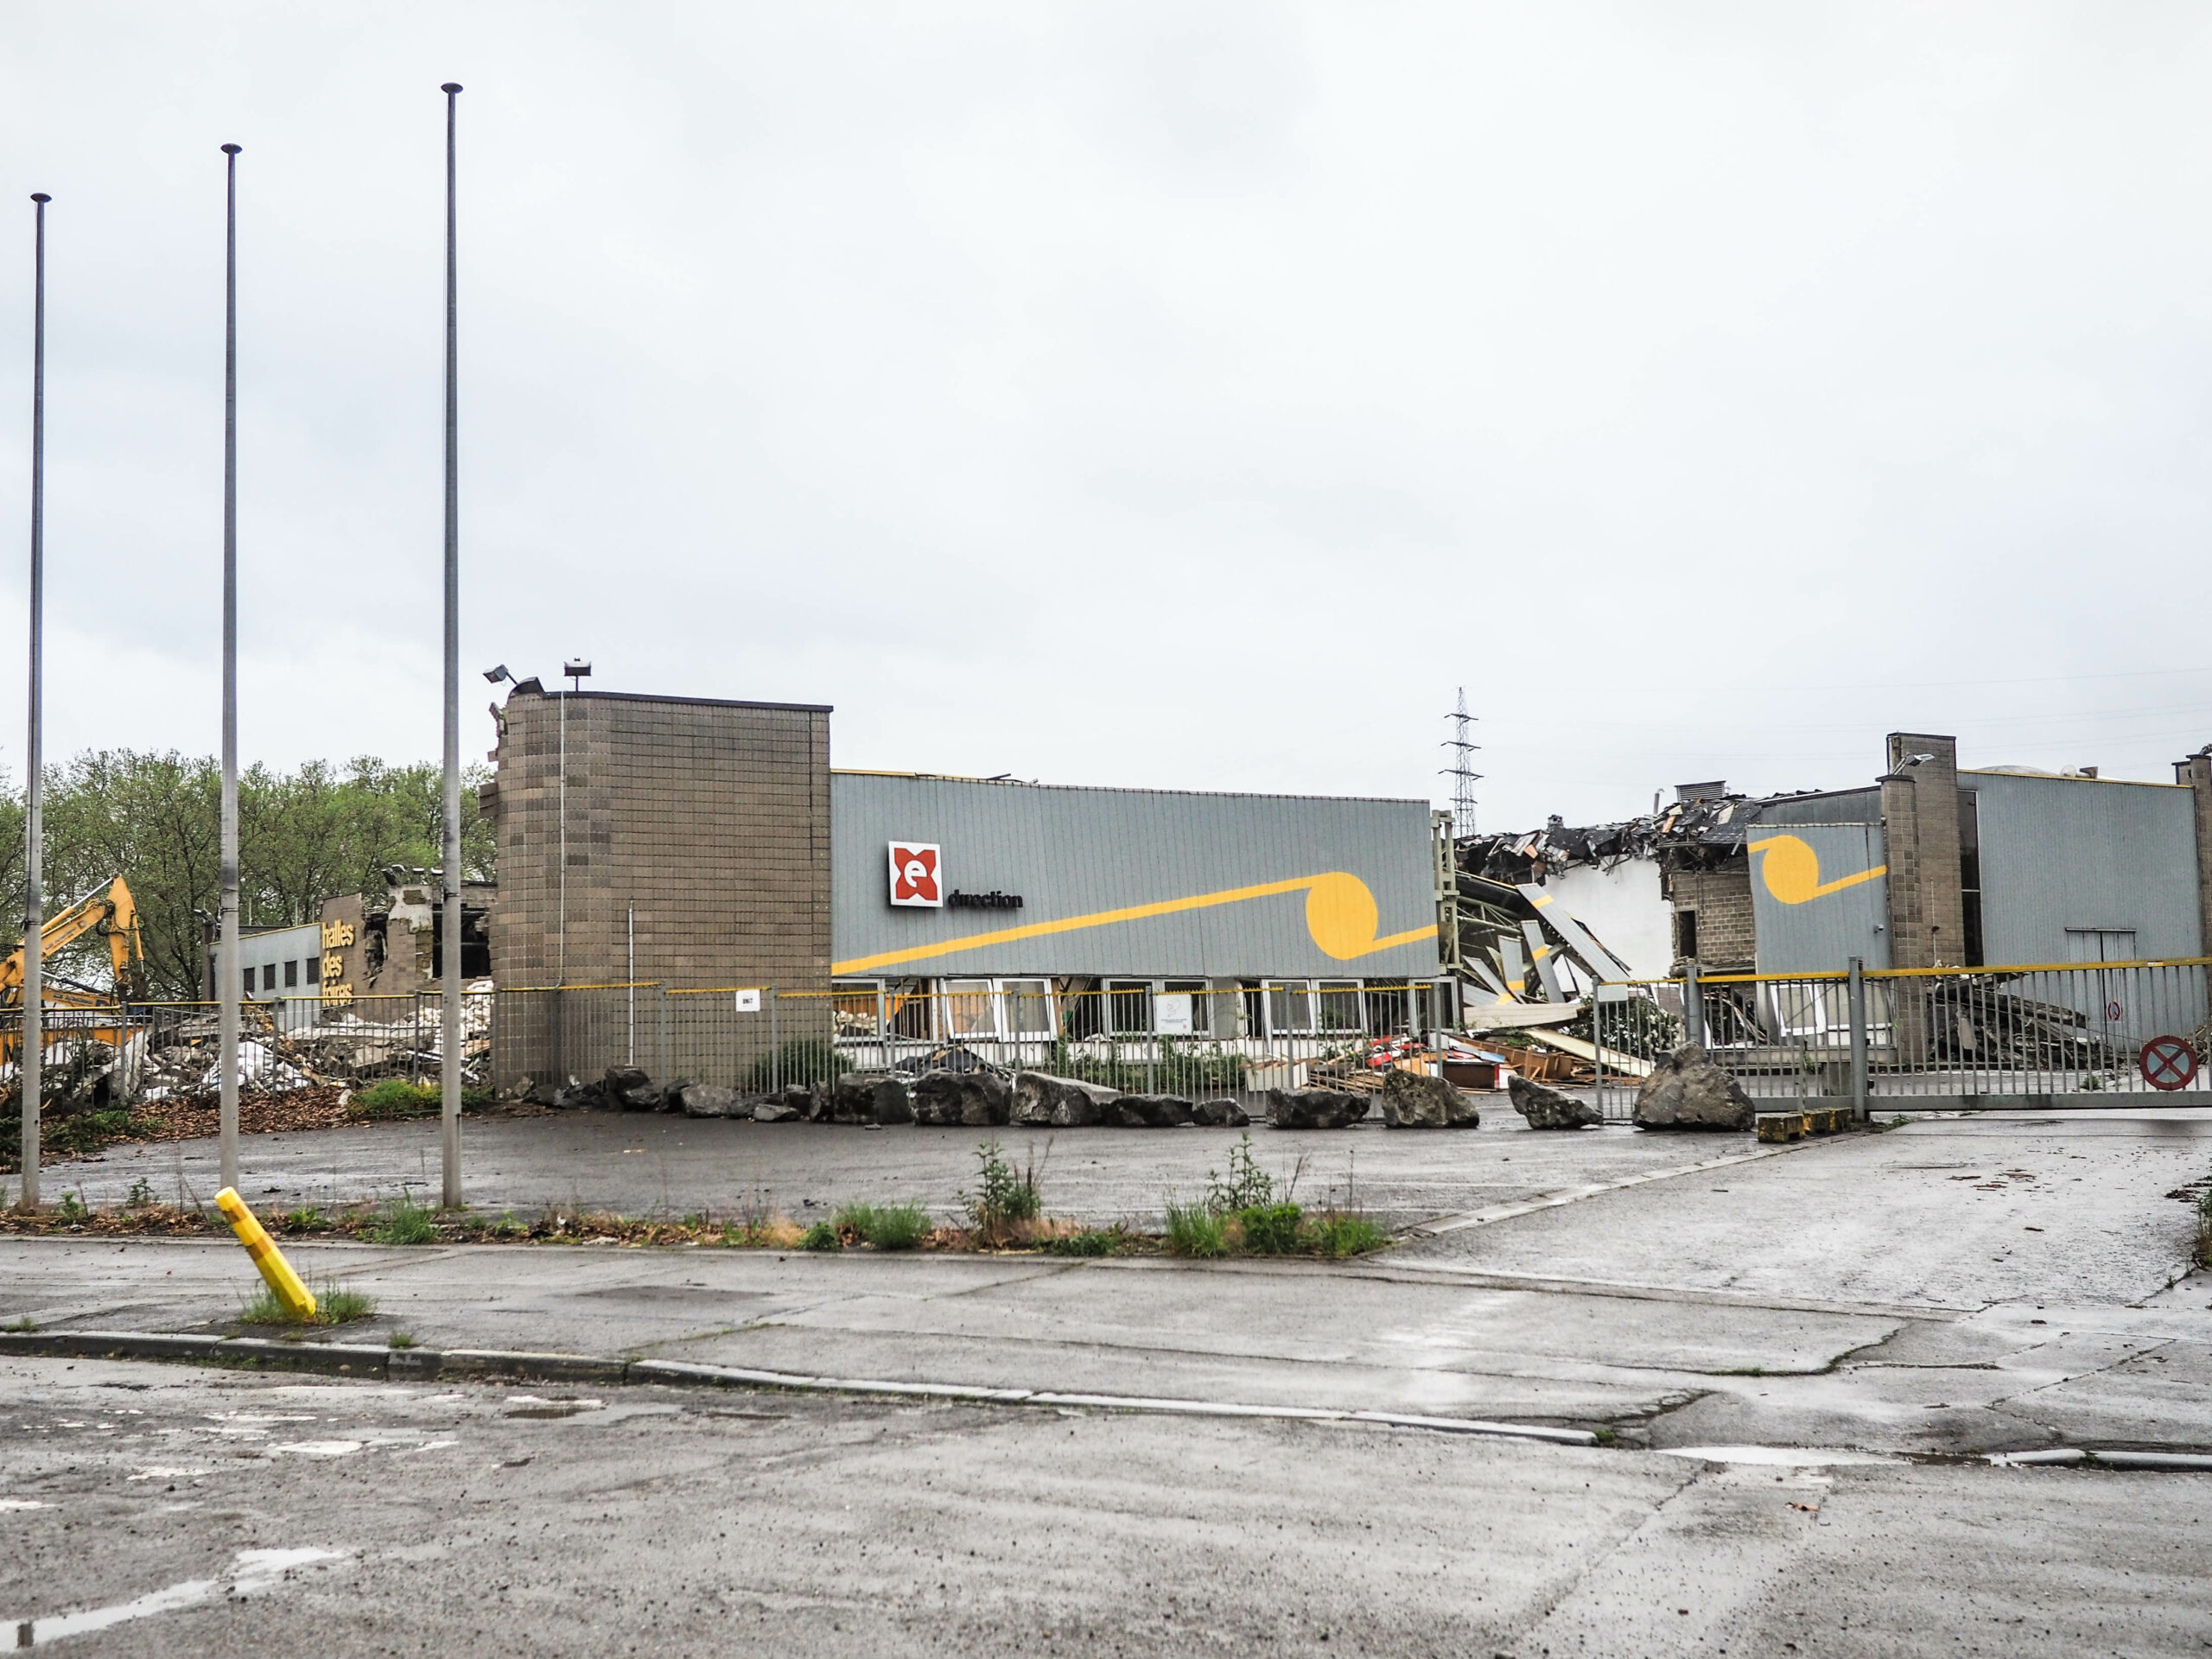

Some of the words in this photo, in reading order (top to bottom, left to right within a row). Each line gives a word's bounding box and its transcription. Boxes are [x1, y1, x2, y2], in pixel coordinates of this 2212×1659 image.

[948, 889, 1023, 908] direction
[322, 918, 355, 950] halles
[322, 950, 344, 978] des
[322, 979, 353, 1007] foires
